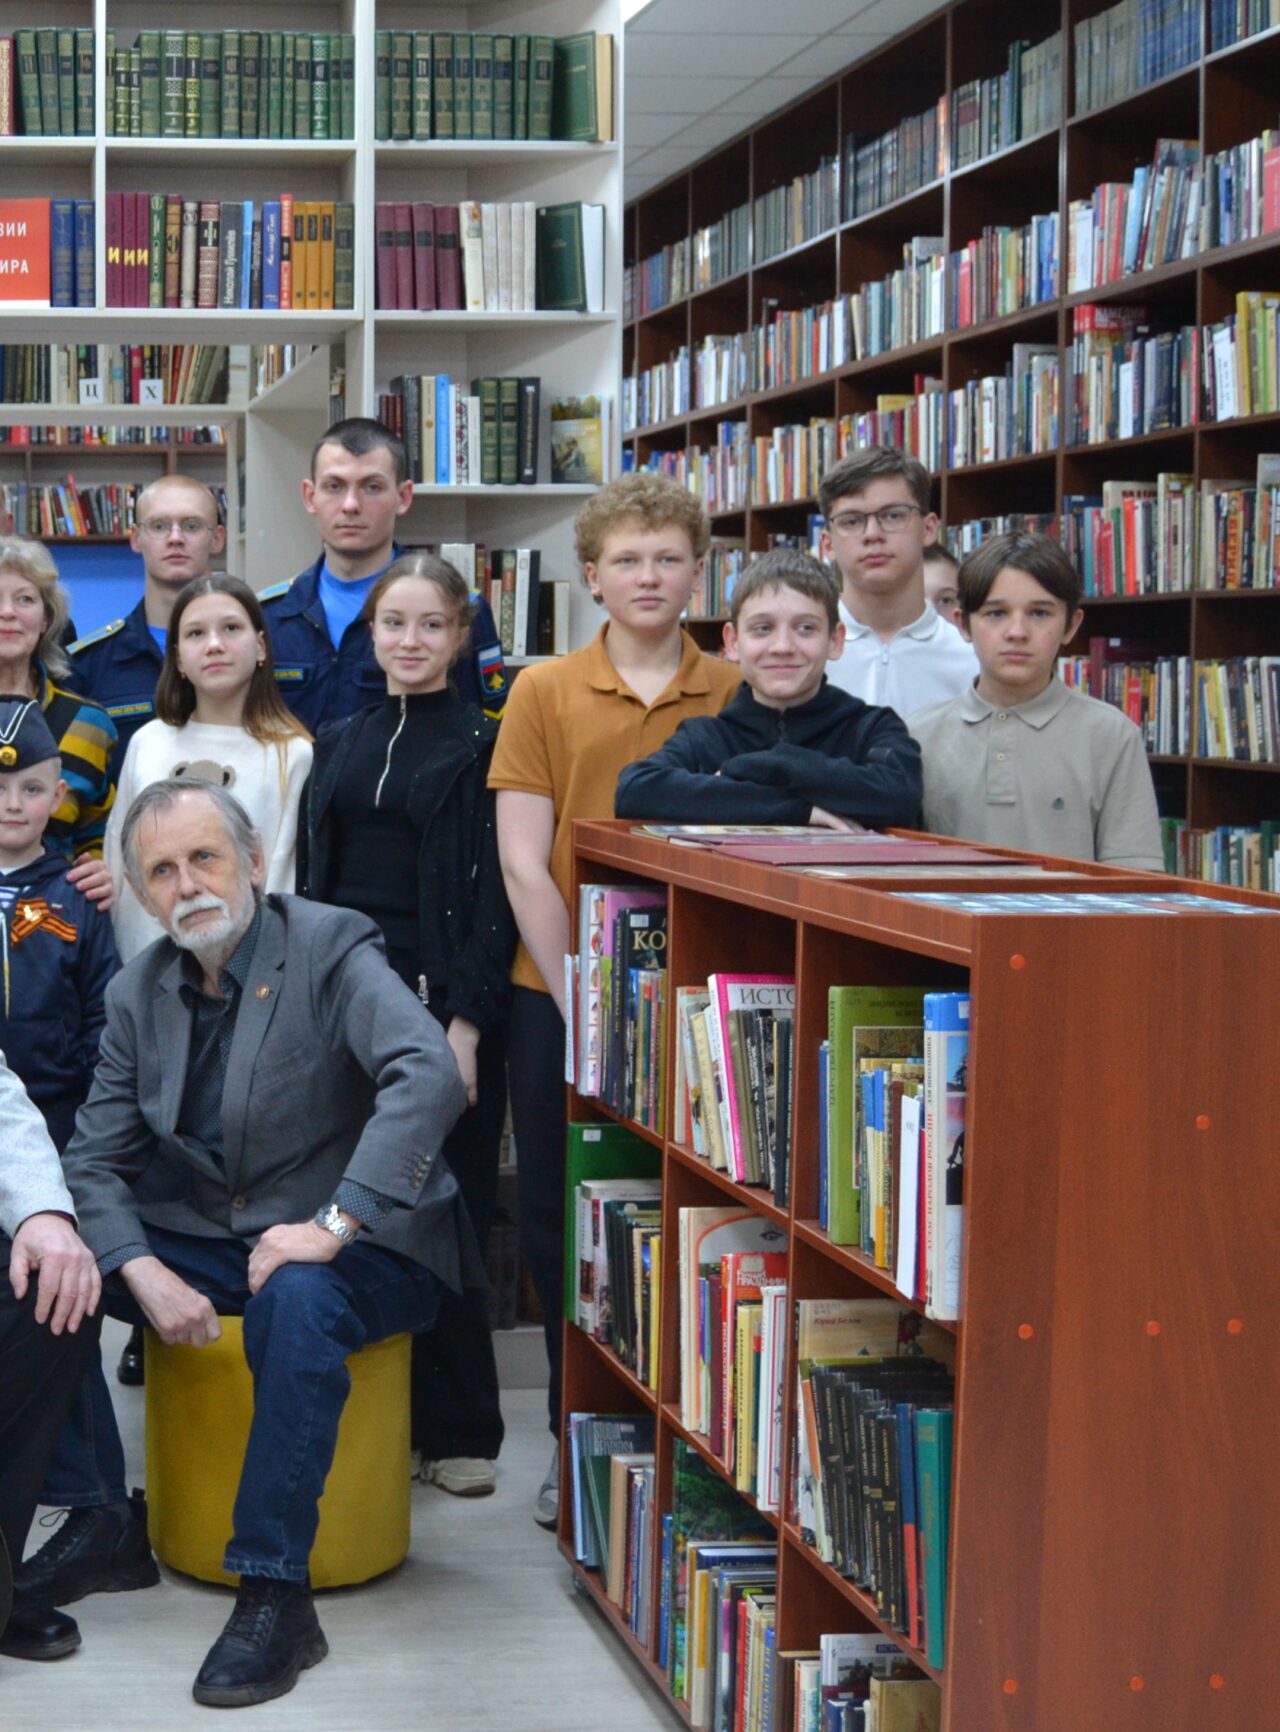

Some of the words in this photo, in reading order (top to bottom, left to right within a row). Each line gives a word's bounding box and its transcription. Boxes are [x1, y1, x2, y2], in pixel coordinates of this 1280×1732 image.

[86, 384, 98, 397] Ц
[145, 386, 157, 398] Х
[632, 930, 666, 950] КО
